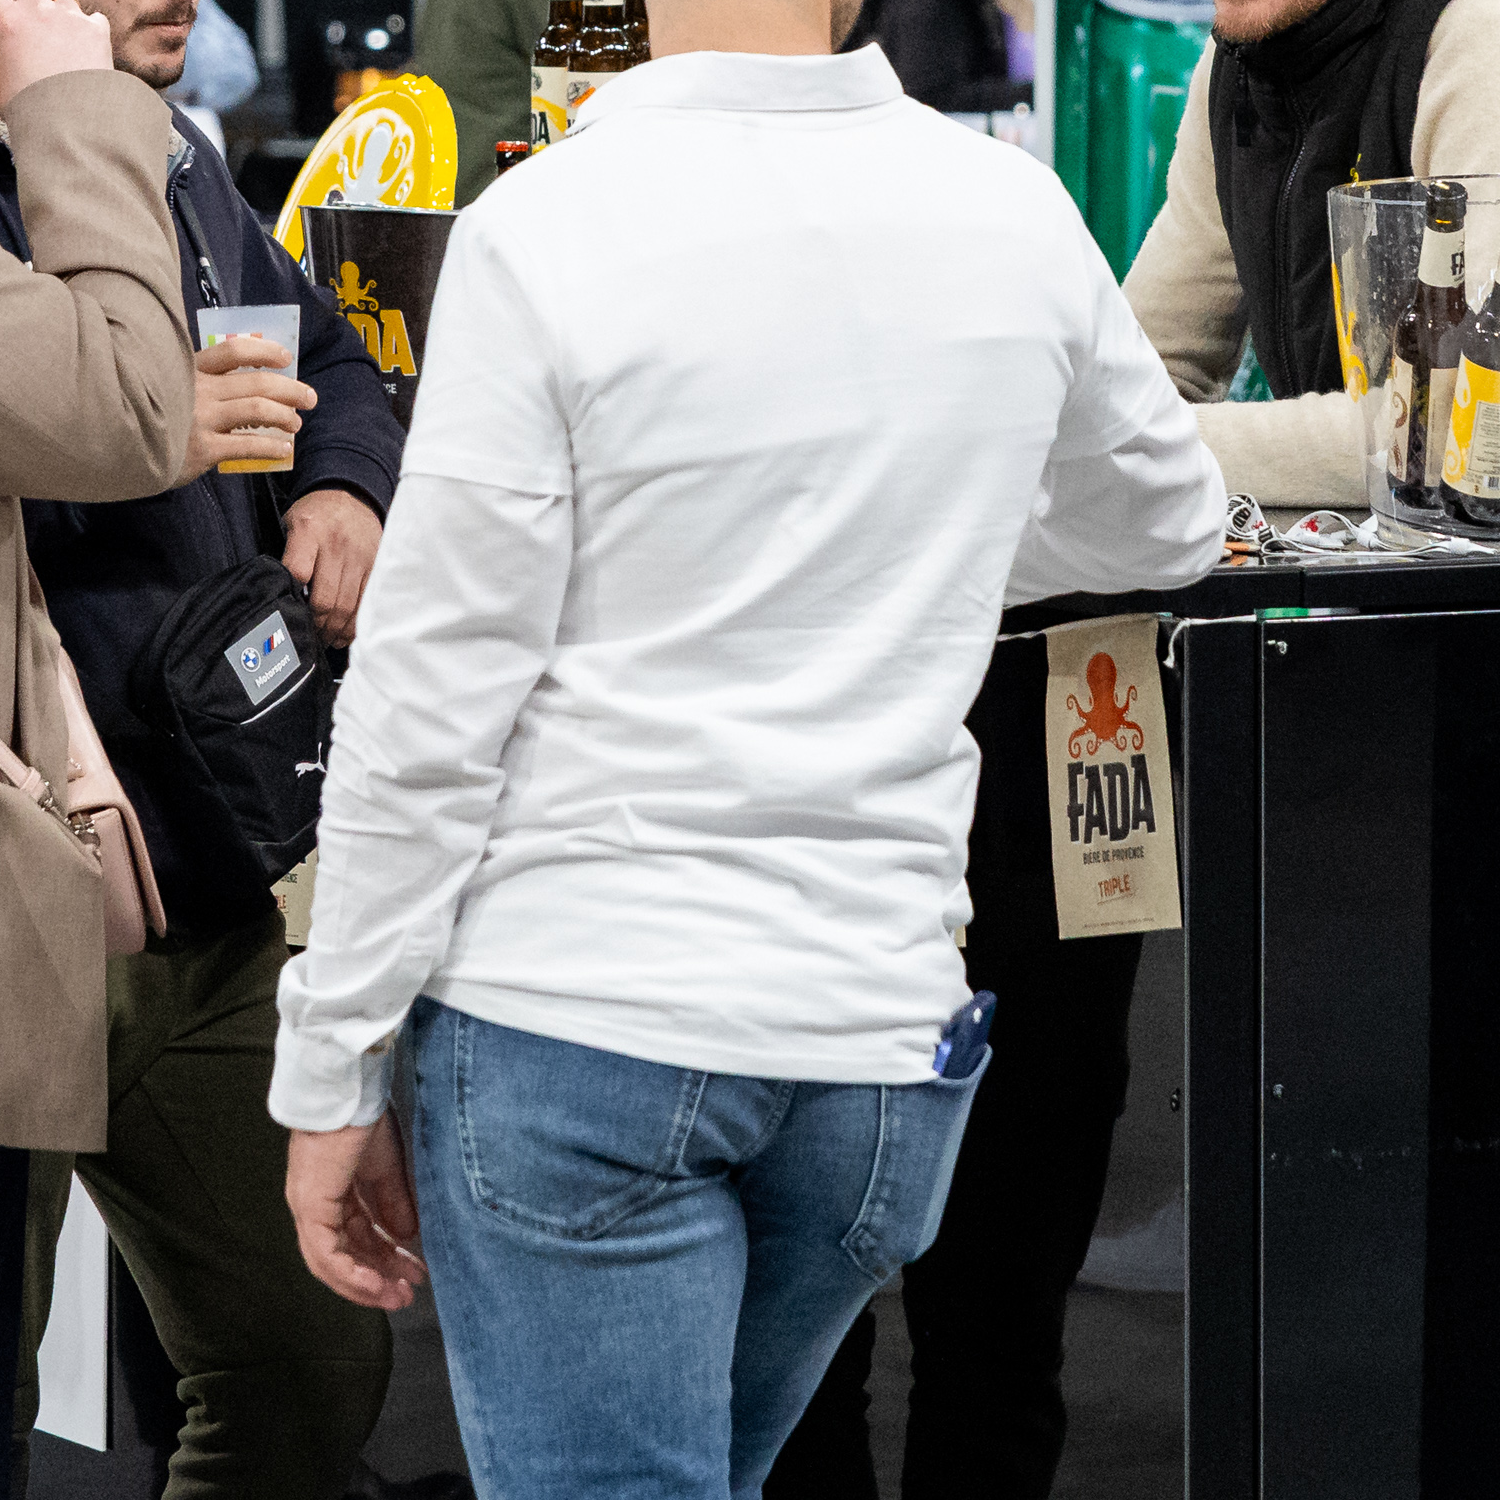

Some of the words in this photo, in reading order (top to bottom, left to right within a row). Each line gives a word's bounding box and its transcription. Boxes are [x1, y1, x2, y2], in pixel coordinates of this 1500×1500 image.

[254, 654, 291, 688] Motorsport
[1067, 753, 1156, 844] FADA
[1098, 873, 1131, 897] TRIPLE
